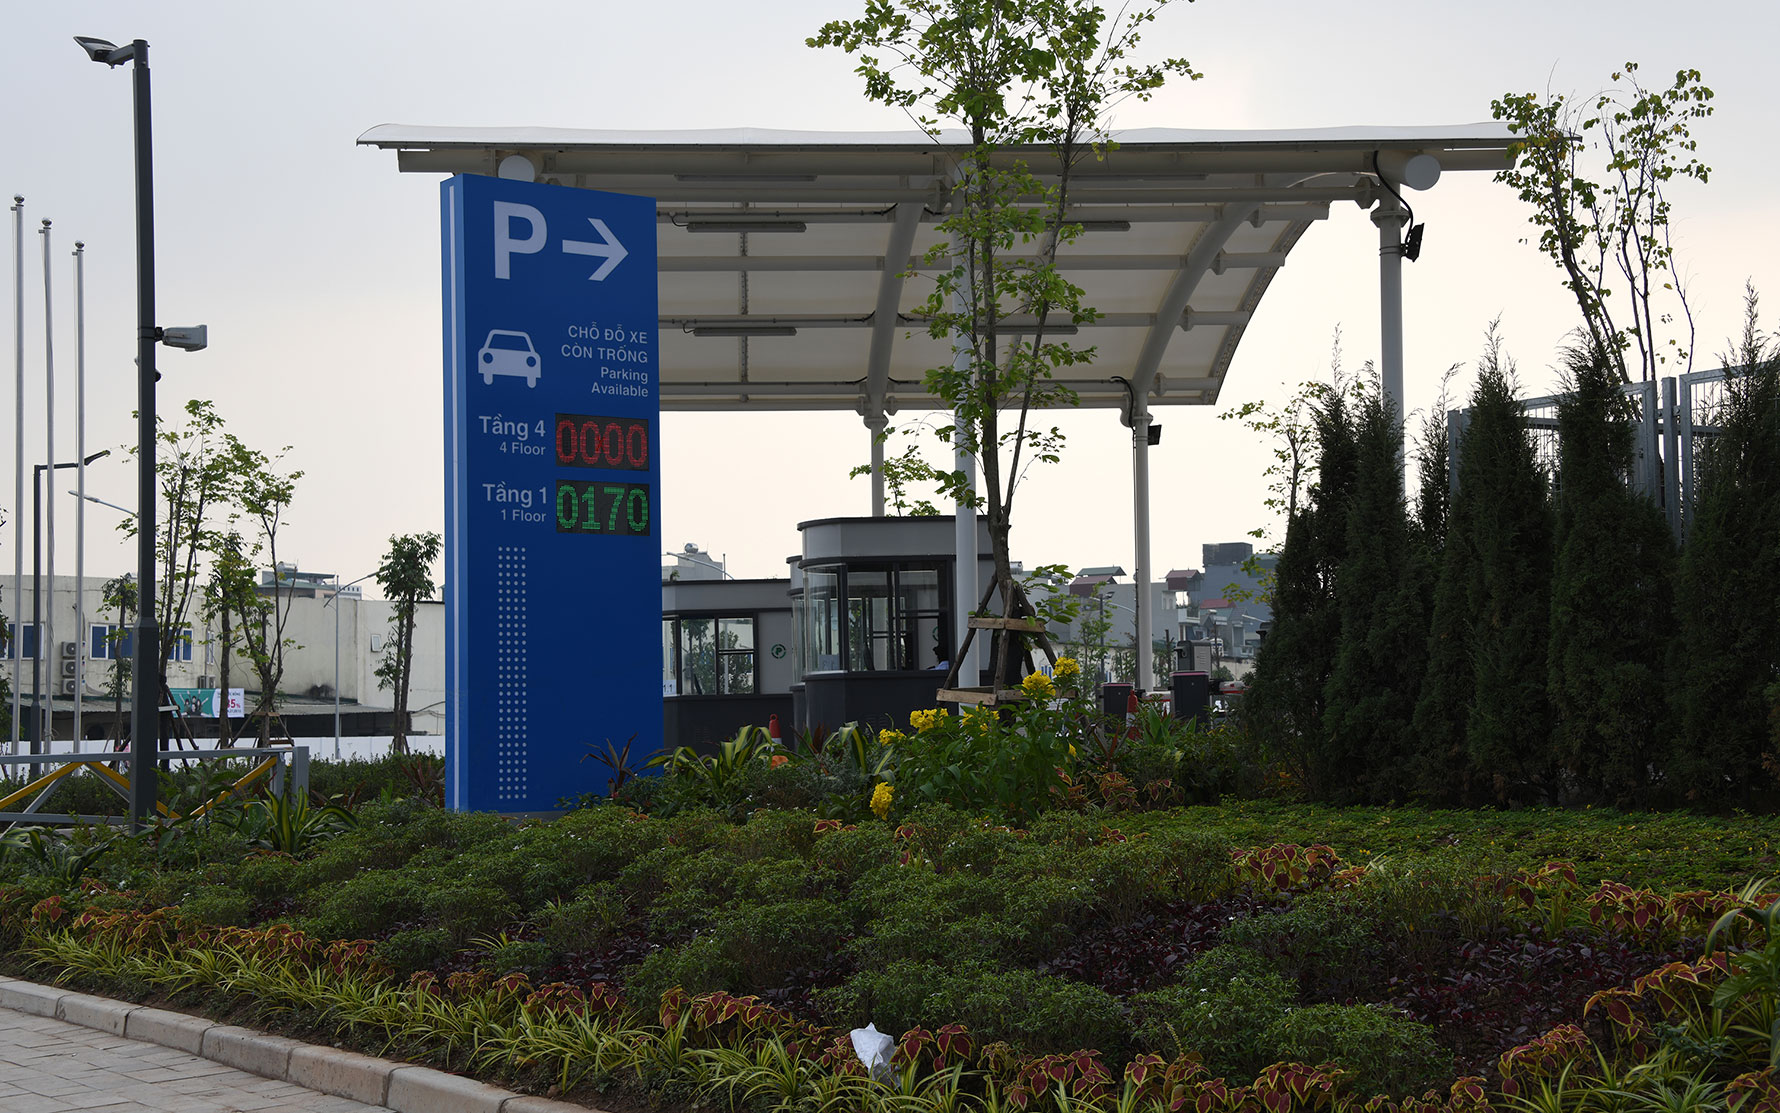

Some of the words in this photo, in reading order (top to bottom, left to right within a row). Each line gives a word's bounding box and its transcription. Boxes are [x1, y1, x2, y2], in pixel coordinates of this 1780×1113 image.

[494, 200, 548, 280] P
[568, 321, 600, 340] CHỖ
[604, 324, 625, 342] ĐỖ
[629, 331, 648, 344] XE
[561, 342, 593, 359] CÒN
[597, 344, 648, 363] TRỐNG
[600, 367, 648, 384] Parking
[591, 382, 649, 397] Available
[478, 414, 529, 440] Tầng
[534, 420, 546, 437] 4
[499, 442, 508, 453] 4
[511, 442, 546, 455] Floor
[556, 420, 648, 467] 0000
[482, 481, 532, 508] Tầng
[539, 487, 547, 504] 1
[501, 509, 507, 520] 1
[512, 509, 546, 522] Floor
[556, 485, 649, 532] 0170
